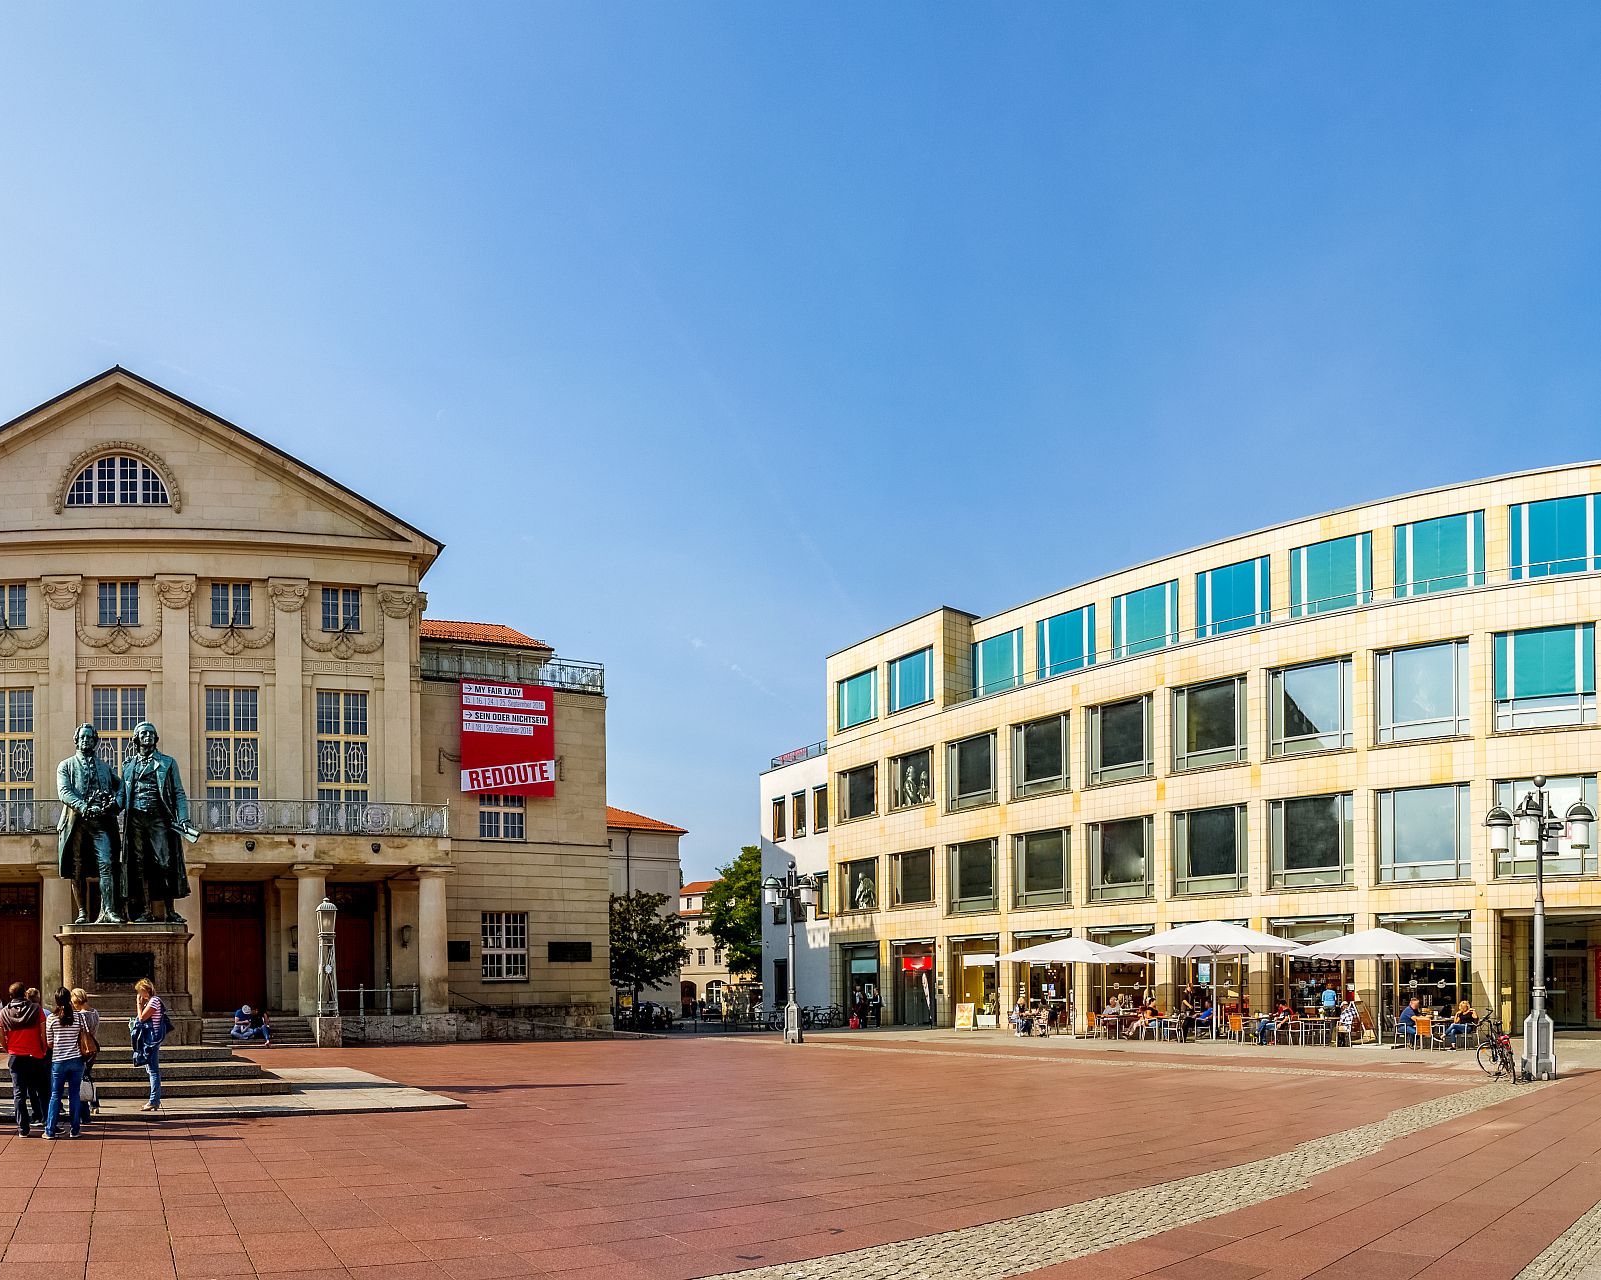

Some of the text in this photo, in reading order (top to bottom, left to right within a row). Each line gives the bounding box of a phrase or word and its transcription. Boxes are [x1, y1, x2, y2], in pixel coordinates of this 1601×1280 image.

[474, 686, 521, 697] MY FAIR LADY
[507, 700, 532, 709] September
[474, 712, 547, 724] SEIN ODER NICHTSEIN
[495, 725, 519, 734] September
[468, 762, 550, 789] REDOUTE
